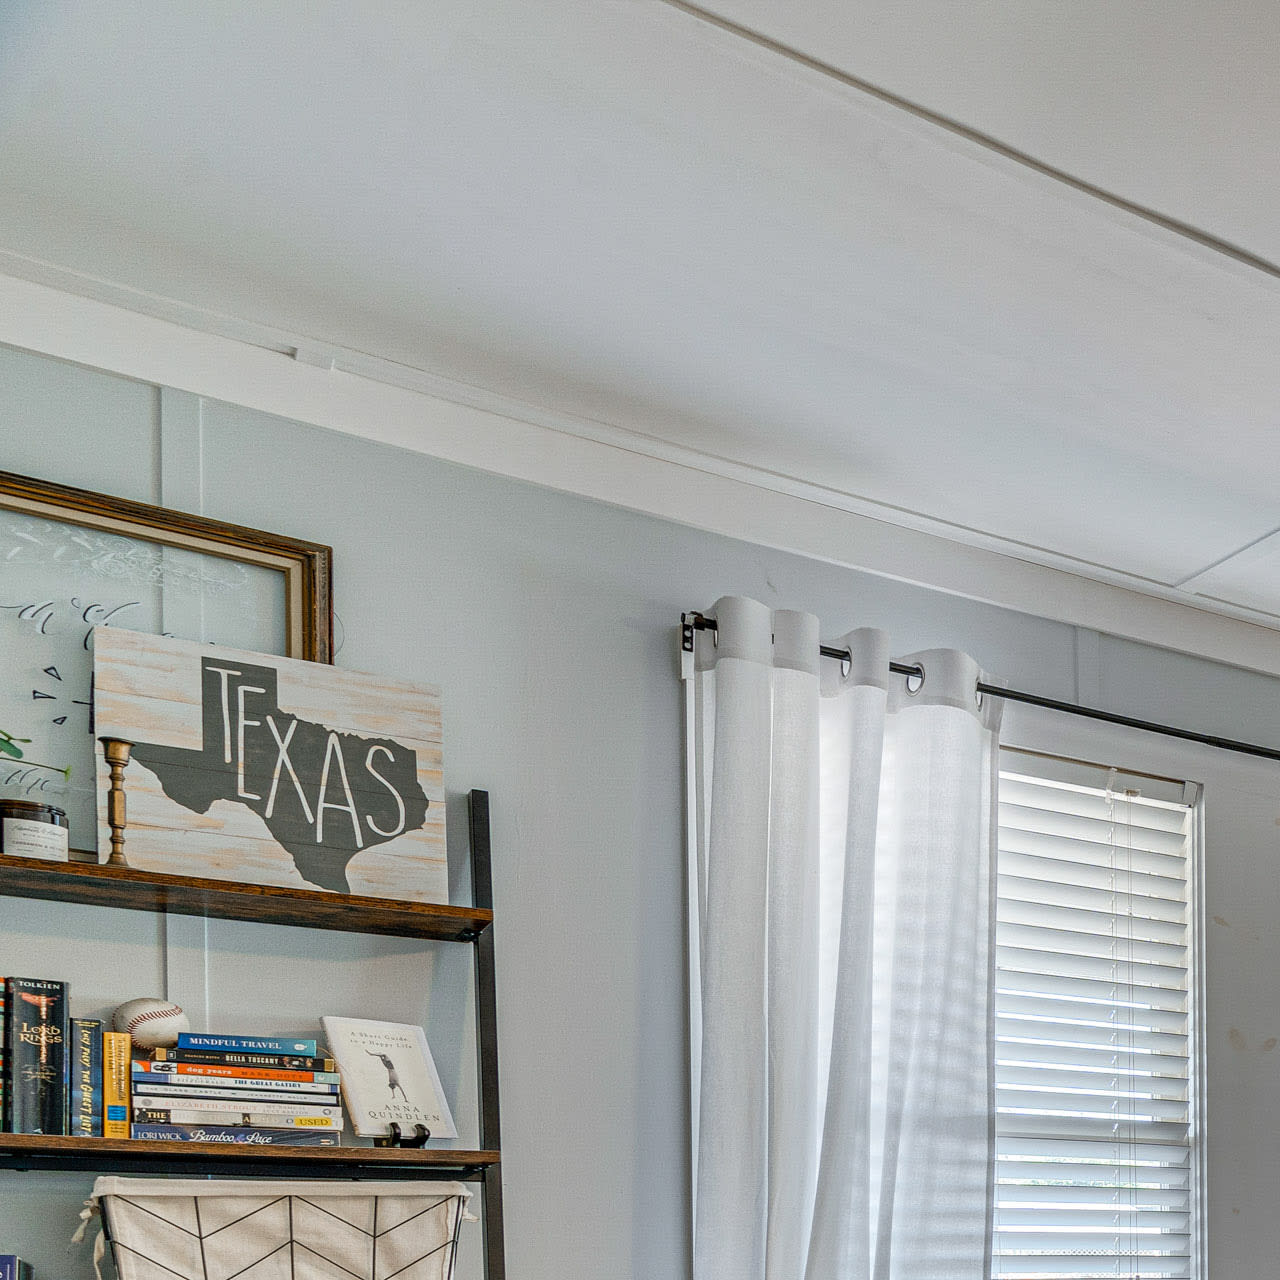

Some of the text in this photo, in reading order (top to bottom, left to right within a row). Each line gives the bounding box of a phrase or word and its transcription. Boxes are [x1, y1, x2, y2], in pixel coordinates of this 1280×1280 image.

[205, 666, 406, 849] TEXAS
[19, 981, 61, 990] TOLKIEN
[22, 1022, 61, 1035] LORD
[19, 1033, 63, 1046] RINGS
[384, 1033, 408, 1041] Guide
[190, 1037, 282, 1050] MINDFUL TRAVEL
[225, 1055, 246, 1063] BELLA
[186, 1066, 233, 1076] dog years
[80, 1070, 93, 1133] THE GUEST LIST
[384, 1104, 420, 1113] ANNA
[147, 1111, 167, 1119] THE
[368, 1110, 440, 1121] QUINDLEN
[299, 1118, 329, 1127] USED
[138, 1131, 182, 1141] LORI WICK
[189, 1129, 235, 1143] Bamboo
[245, 1134, 273, 1145] Lace
